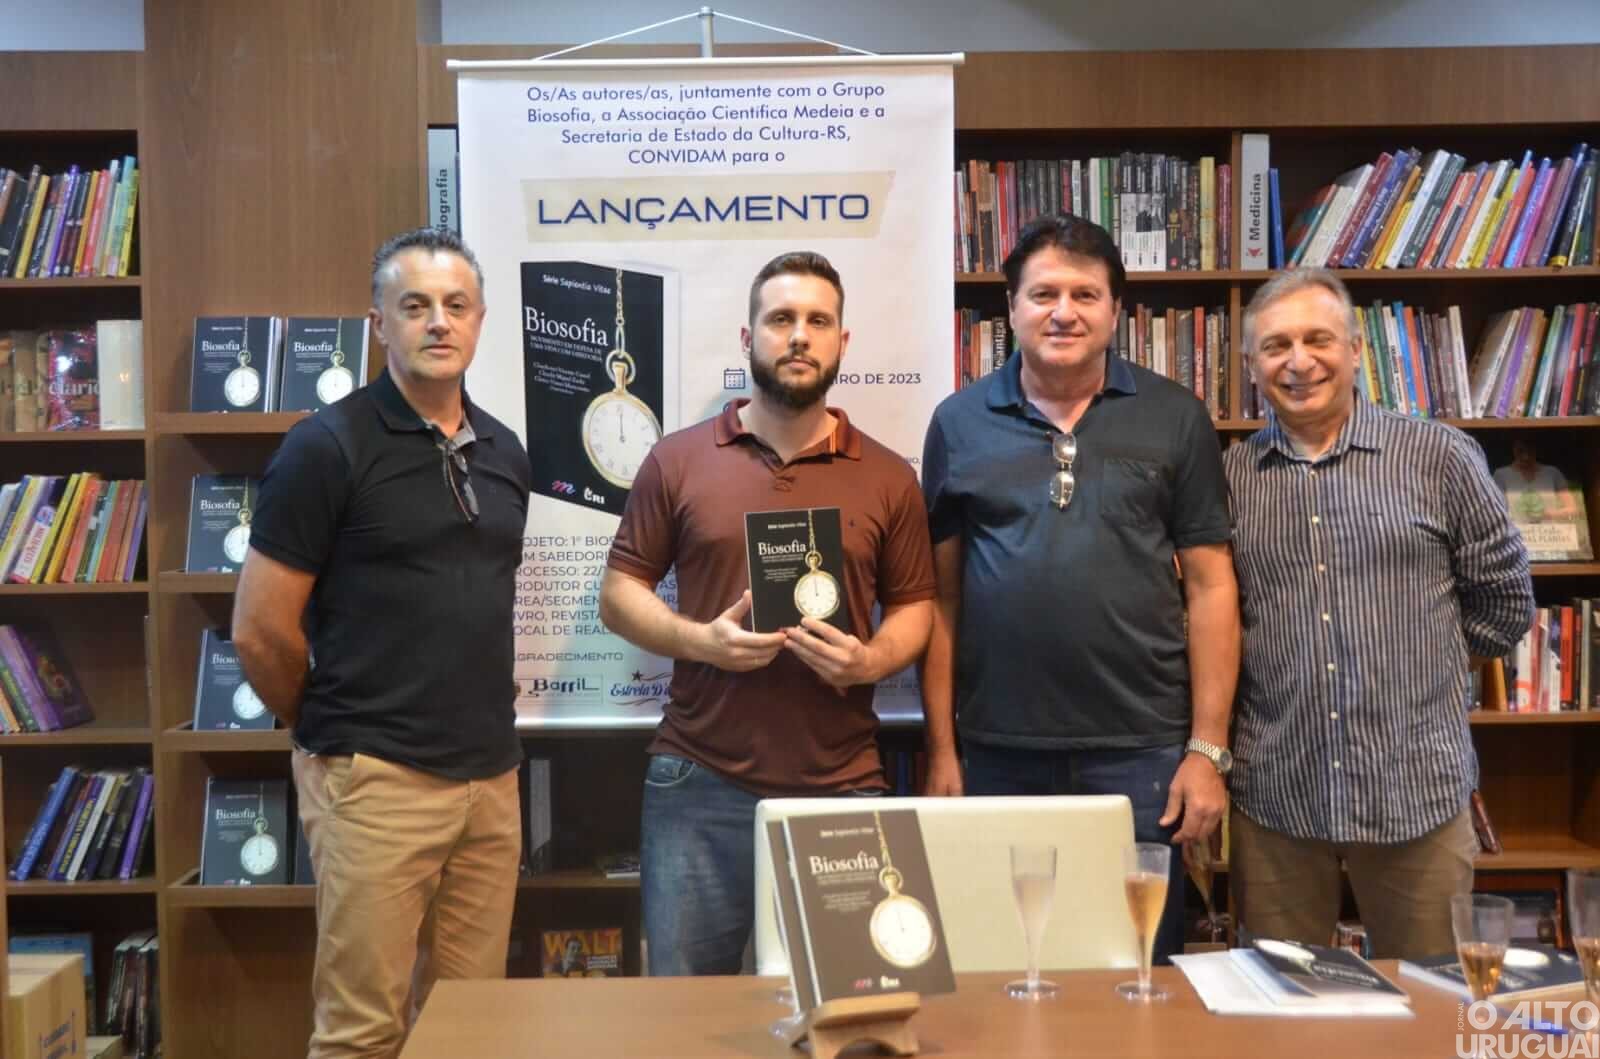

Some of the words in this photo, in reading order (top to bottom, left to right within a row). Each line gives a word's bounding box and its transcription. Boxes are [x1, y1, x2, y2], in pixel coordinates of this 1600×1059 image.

[527, 86, 577, 101] Os/As
[582, 85, 673, 101] autores/as,
[679, 85, 771, 102] juntamente
[777, 87, 811, 97] com
[816, 86, 827, 97] o
[832, 82, 885, 99] Grupo
[527, 107, 596, 124] Biosofia,
[601, 111, 611, 122] a
[617, 106, 706, 124] Associação
[712, 104, 788, 120] Científica
[793, 104, 854, 118] Medeia
[859, 106, 869, 118] e
[874, 106, 885, 118] a
[561, 128, 642, 144] Secretaria
[648, 128, 668, 142] de
[674, 127, 727, 142] Estado
[732, 126, 753, 141] da
[759, 125, 851, 142] Cultura-RS,
[628, 149, 727, 164] CONVIDAM
[732, 151, 769, 166] para
[775, 151, 785, 162] o
[435, 168, 451, 232] iografia
[1249, 173, 1261, 241] Medicina
[538, 194, 869, 230] LANÇAMENTO
[524, 306, 609, 347] Biosofia
[201, 339, 241, 352] Biosofia
[293, 341, 333, 353] Biosofia
[834, 373, 861, 385] IRO
[864, 373, 885, 385] DE
[888, 372, 921, 385] 2023
[200, 498, 241, 511] Biosofia
[521, 535, 568, 547] OJETO:
[757, 539, 807, 556] Biosofia
[539, 552, 609, 561] SABEDORI
[552, 626, 571, 636] DE
[516, 652, 624, 662] GRADECIMENTO
[215, 807, 257, 820] Biosofia
[808, 850, 880, 876] Biosofia
